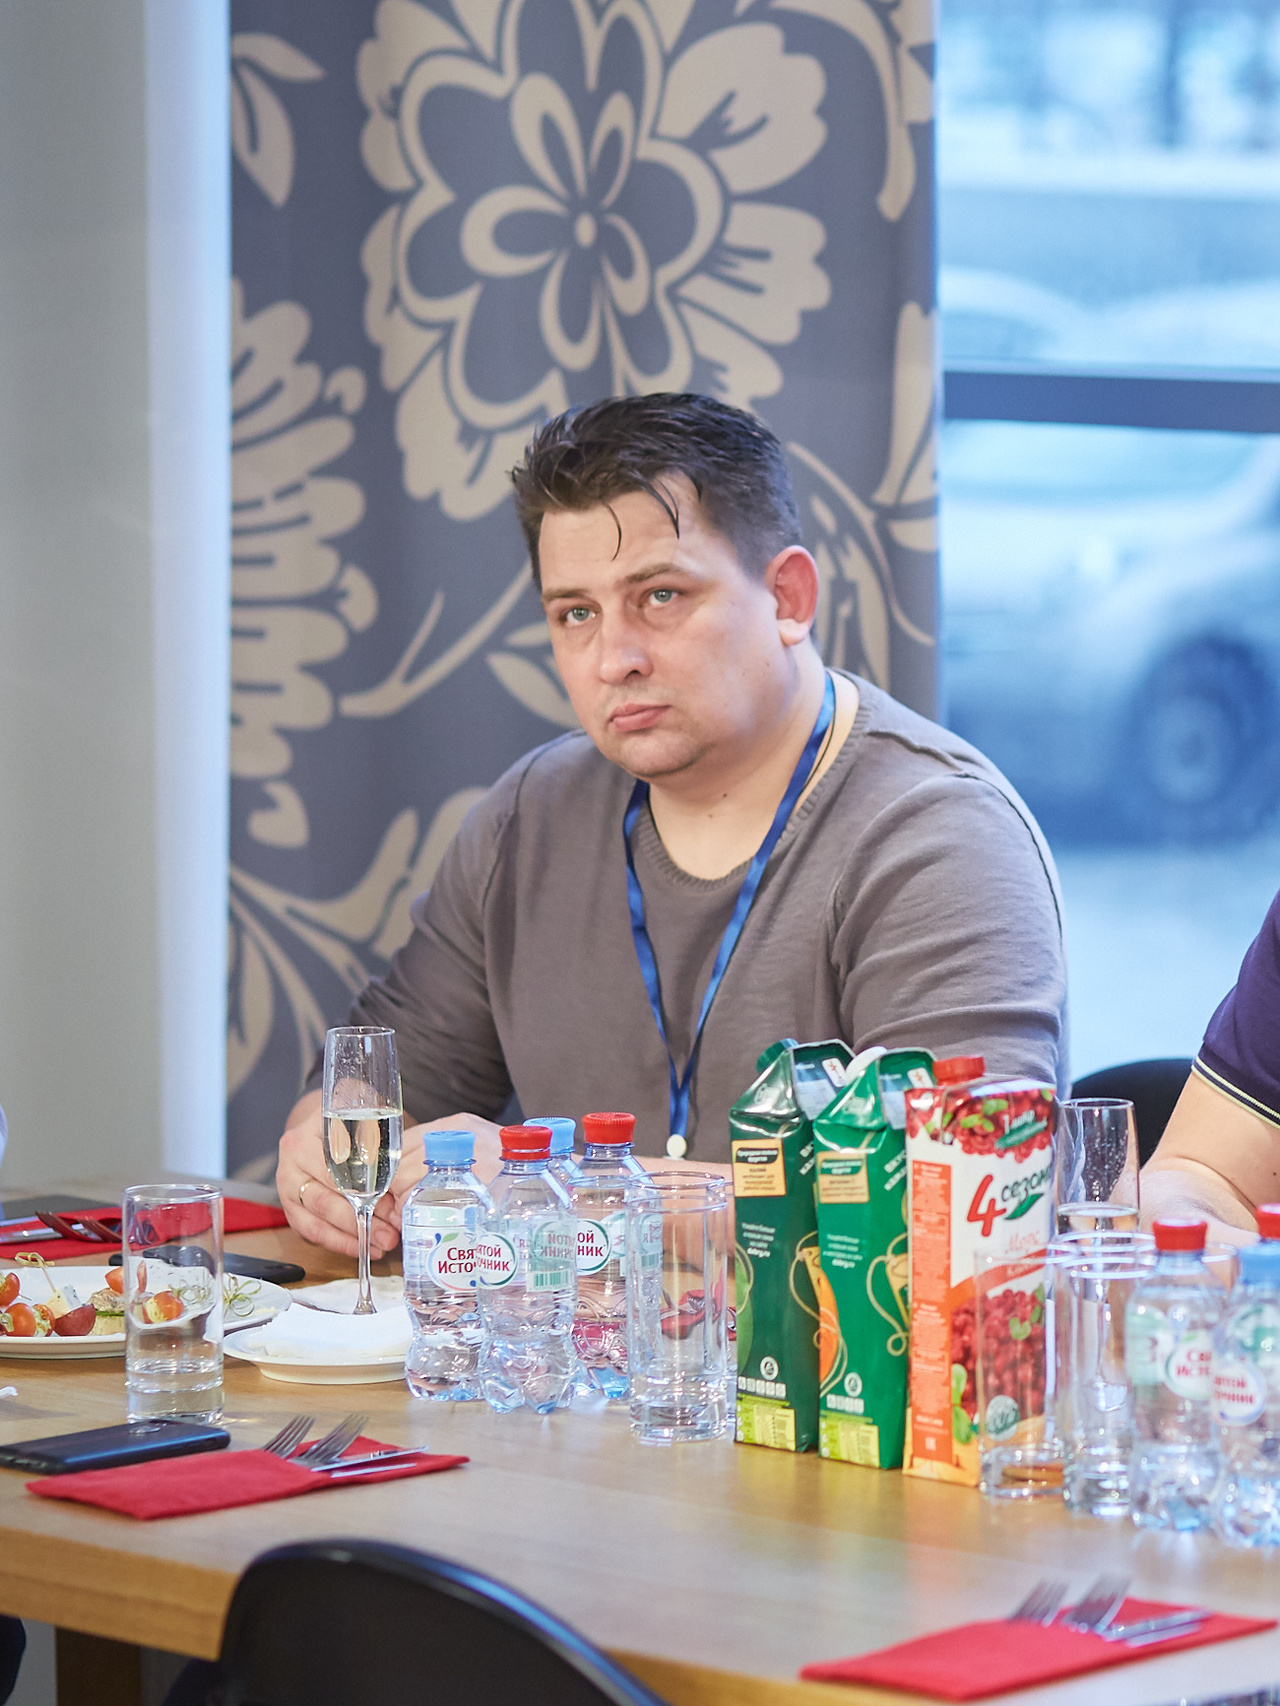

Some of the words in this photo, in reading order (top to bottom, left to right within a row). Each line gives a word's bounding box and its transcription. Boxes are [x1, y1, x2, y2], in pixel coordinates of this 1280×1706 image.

[966, 1174, 1007, 1238] 4
[1001, 1161, 1053, 1204] сезон
[446, 1247, 477, 1261] Свя
[438, 1260, 477, 1274] Исто
